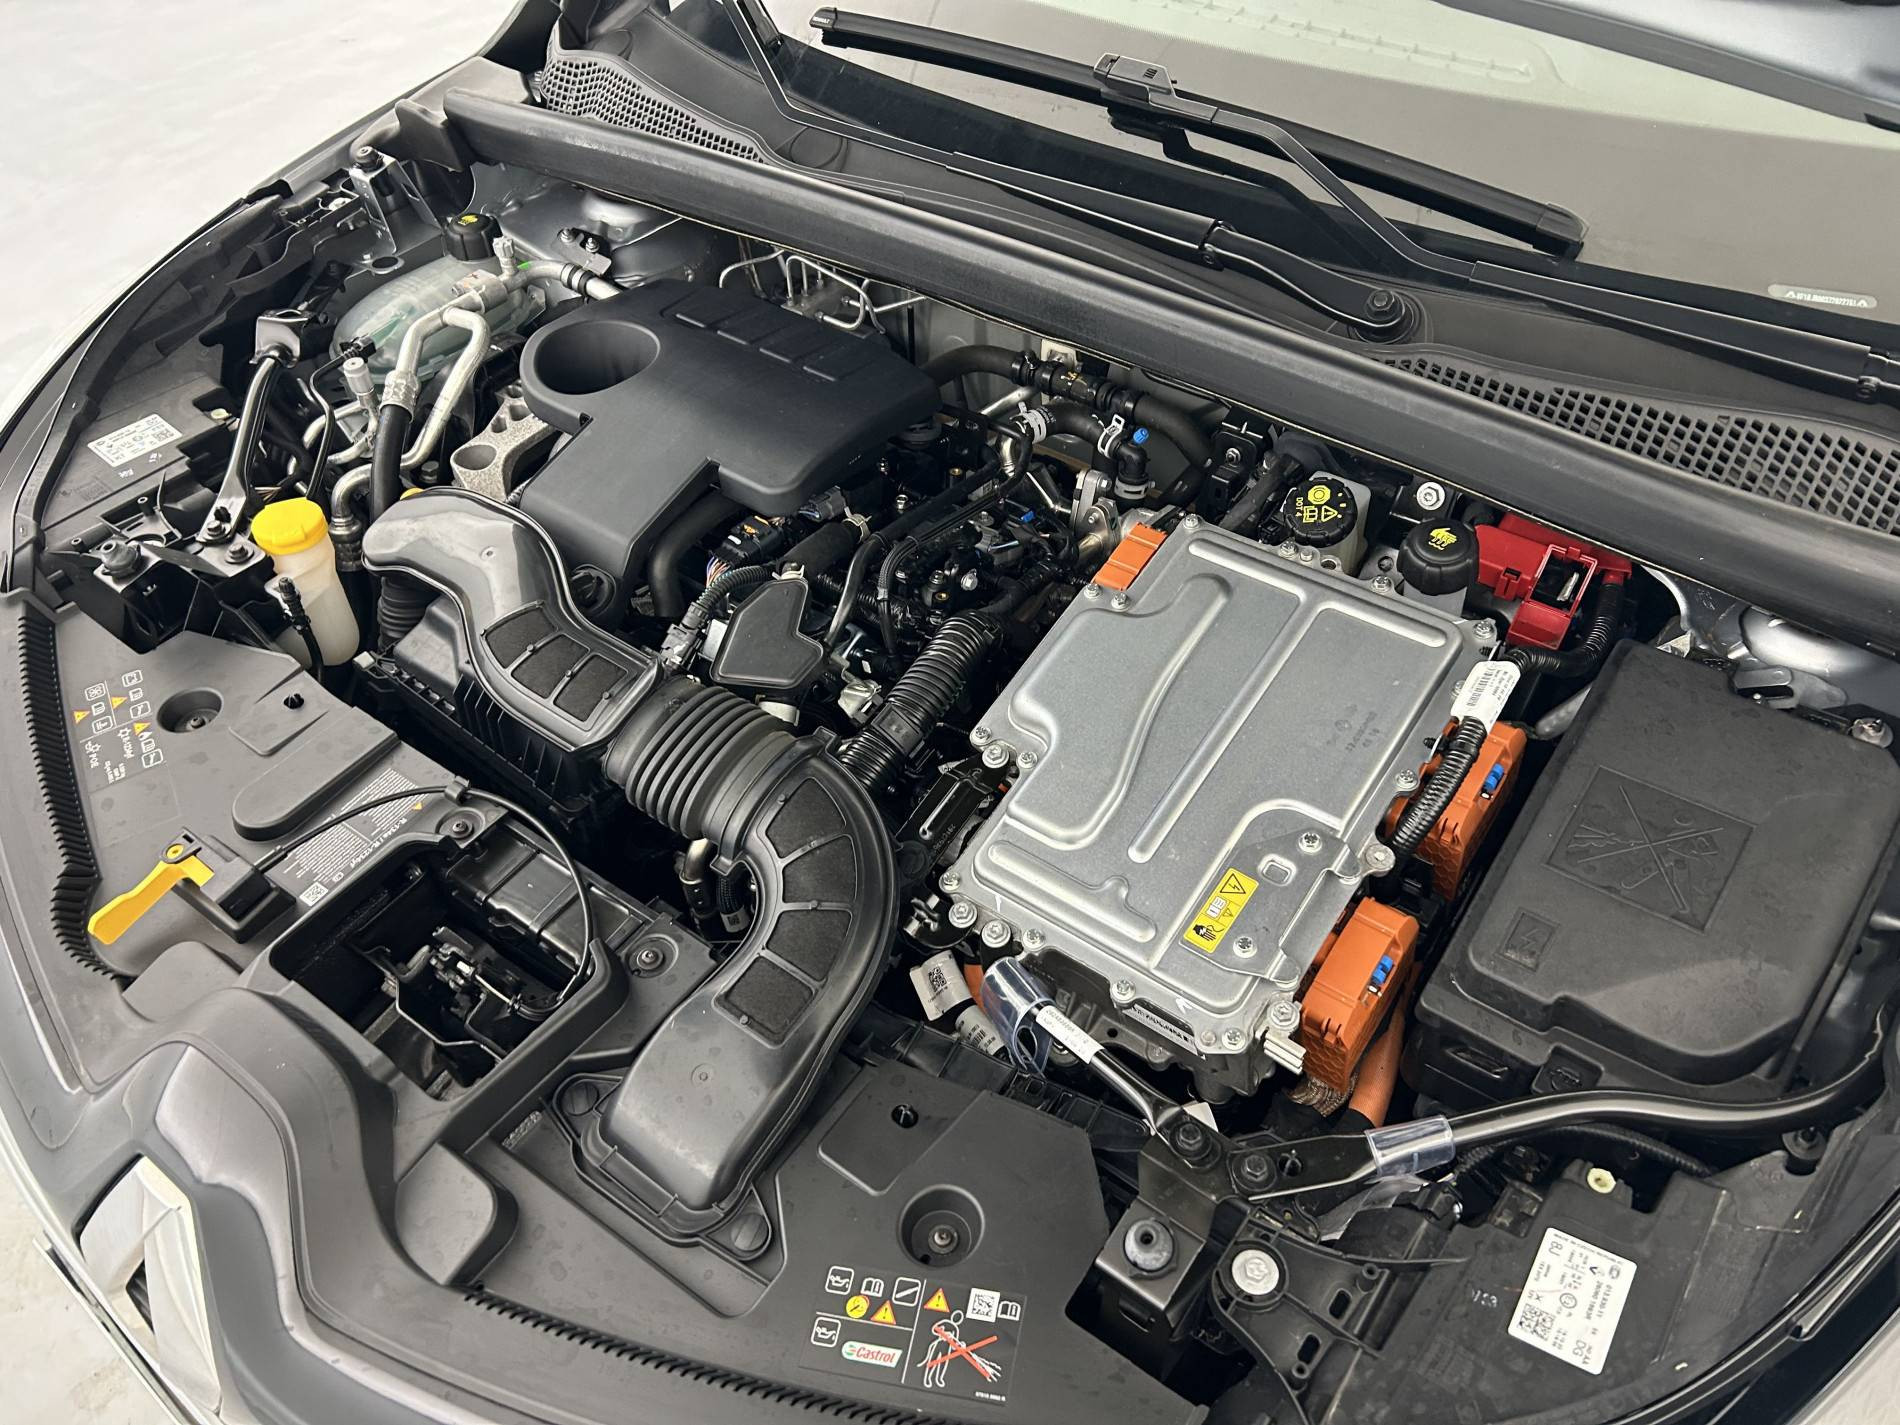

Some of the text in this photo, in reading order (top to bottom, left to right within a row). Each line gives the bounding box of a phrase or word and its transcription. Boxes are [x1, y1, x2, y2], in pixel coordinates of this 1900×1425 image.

[1295, 496, 1304, 511] DOT
[856, 1346, 896, 1363] Castrol
[1572, 1339, 1587, 1358] DG
